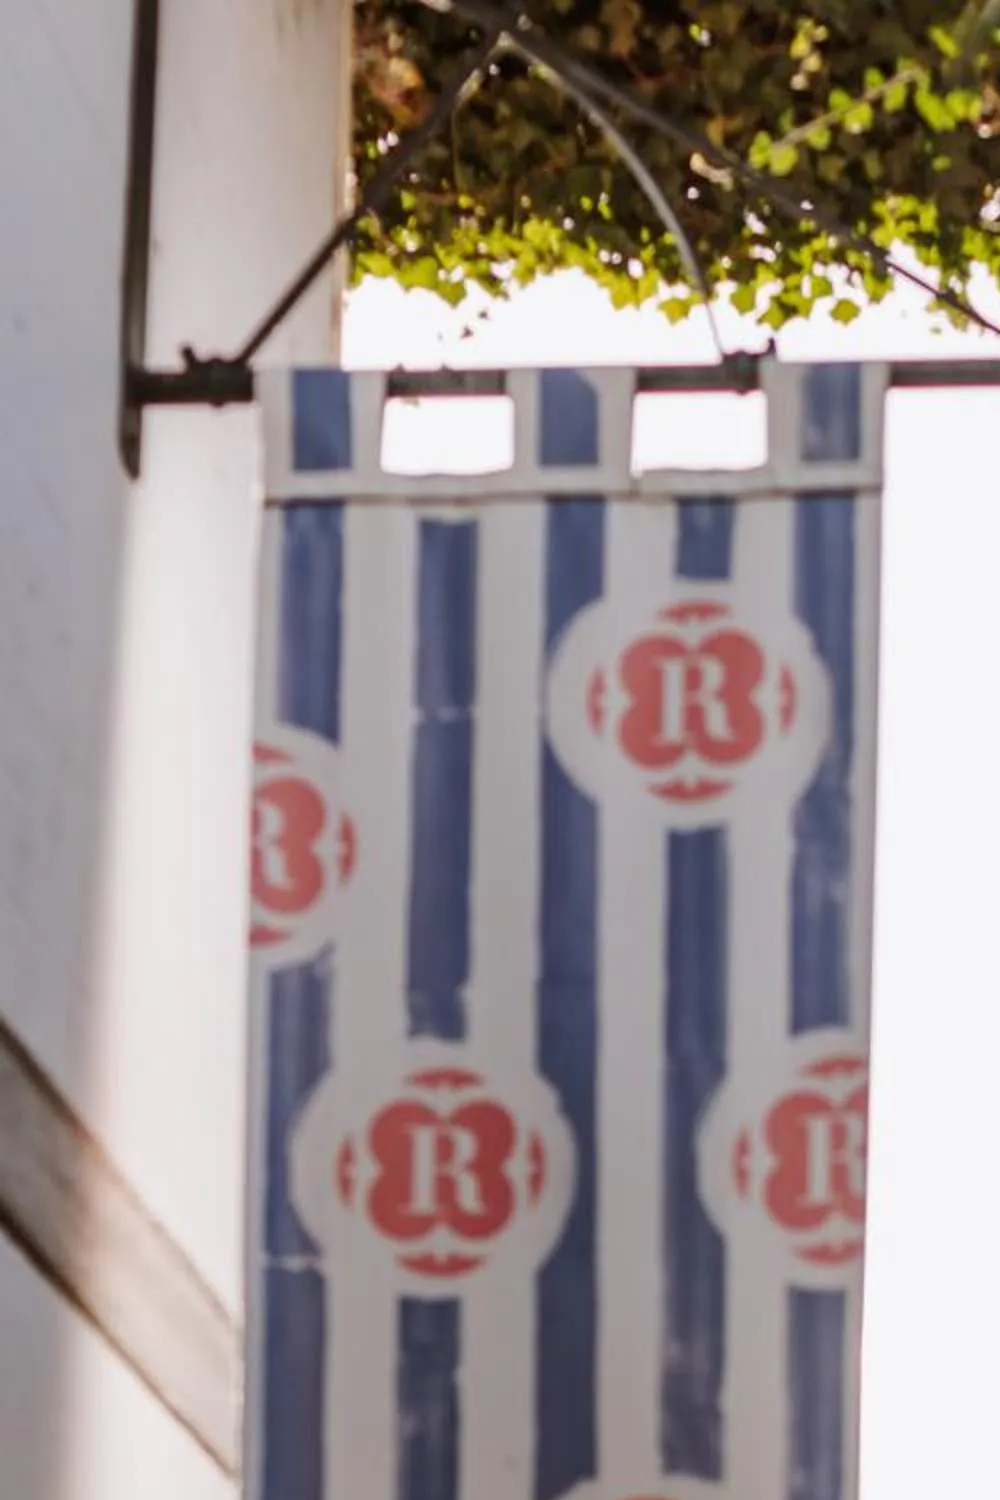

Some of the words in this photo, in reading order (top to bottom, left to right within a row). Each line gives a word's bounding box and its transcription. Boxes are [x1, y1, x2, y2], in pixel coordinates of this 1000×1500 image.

[658, 657, 736, 743] R
[403, 1127, 486, 1217] R
[801, 1116, 866, 1203] R
